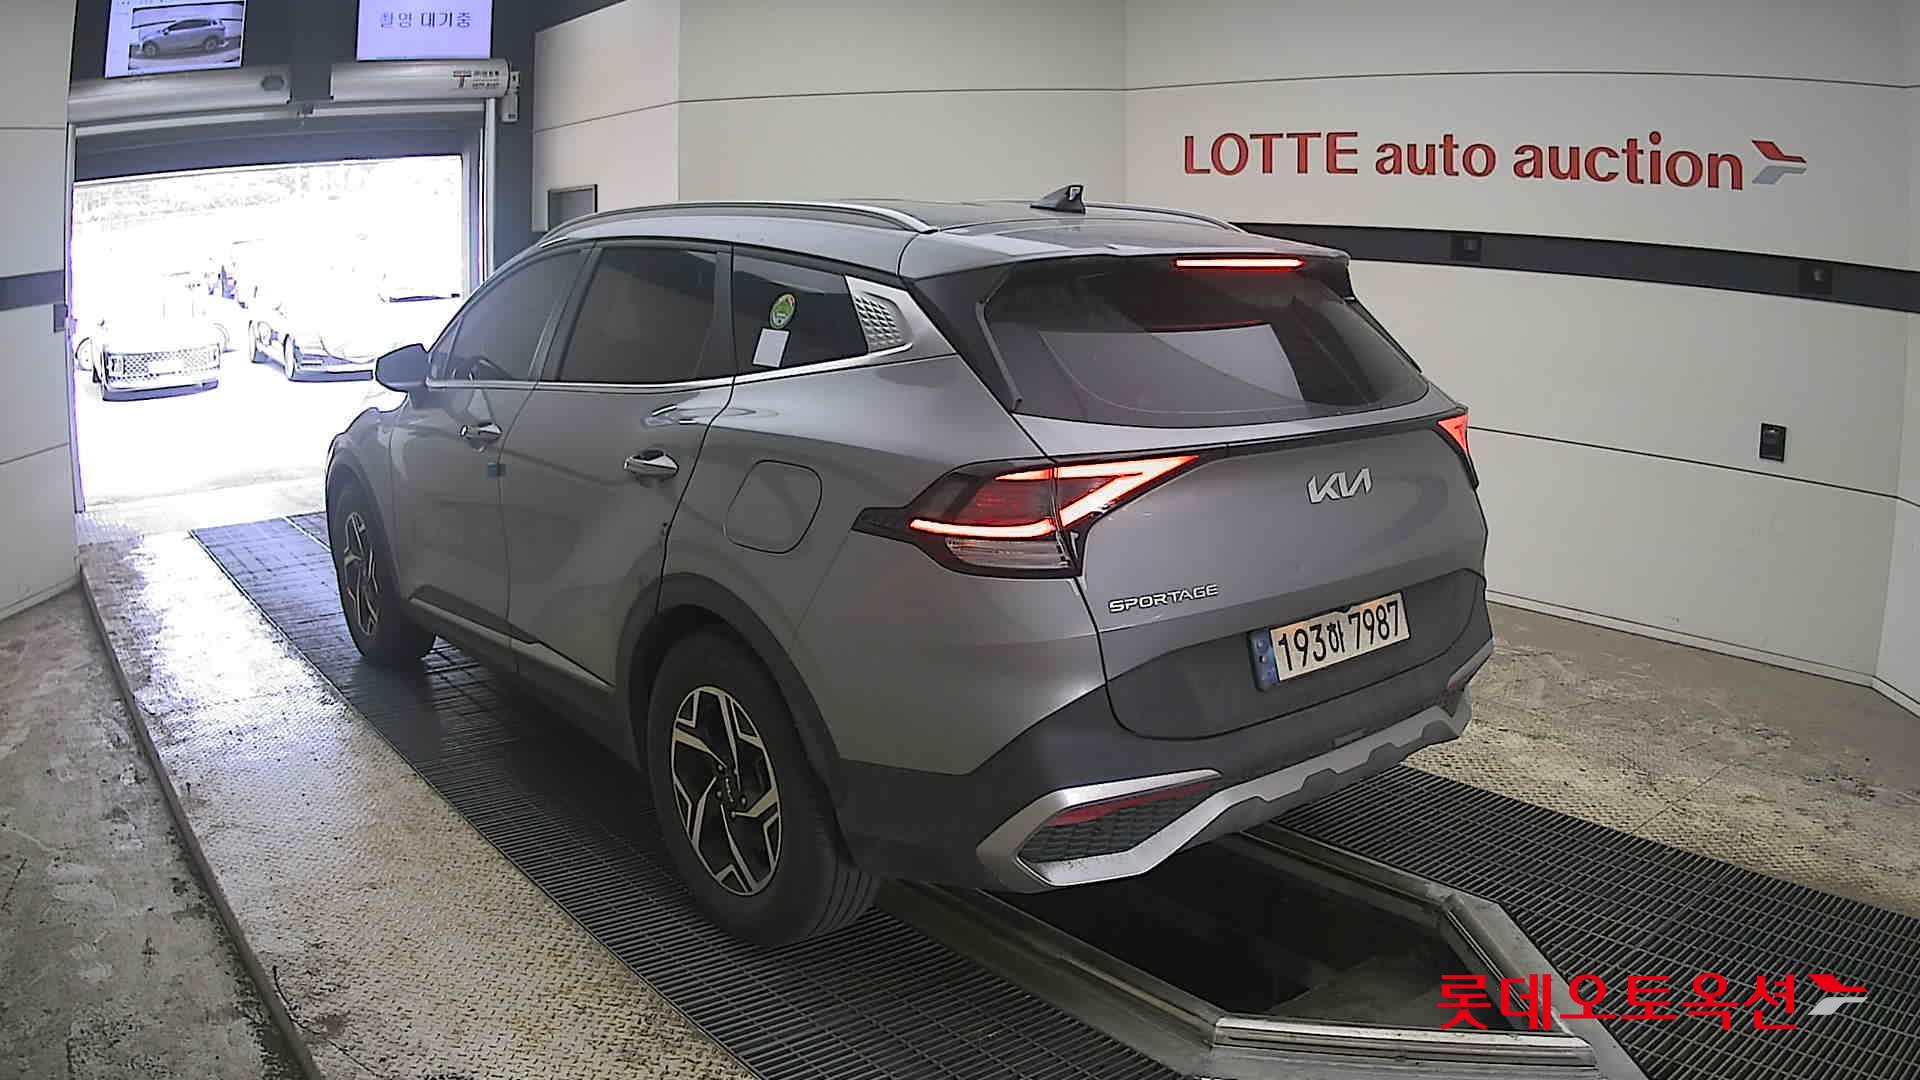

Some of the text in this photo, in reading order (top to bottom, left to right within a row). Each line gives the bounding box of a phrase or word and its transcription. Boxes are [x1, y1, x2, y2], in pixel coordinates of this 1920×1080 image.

[1184, 131, 1744, 190] LOTTE auto auction
[1307, 466, 1373, 504] KIA
[1109, 583, 1219, 613] SPORTAGE
[1278, 600, 1400, 672] 193하 7987
